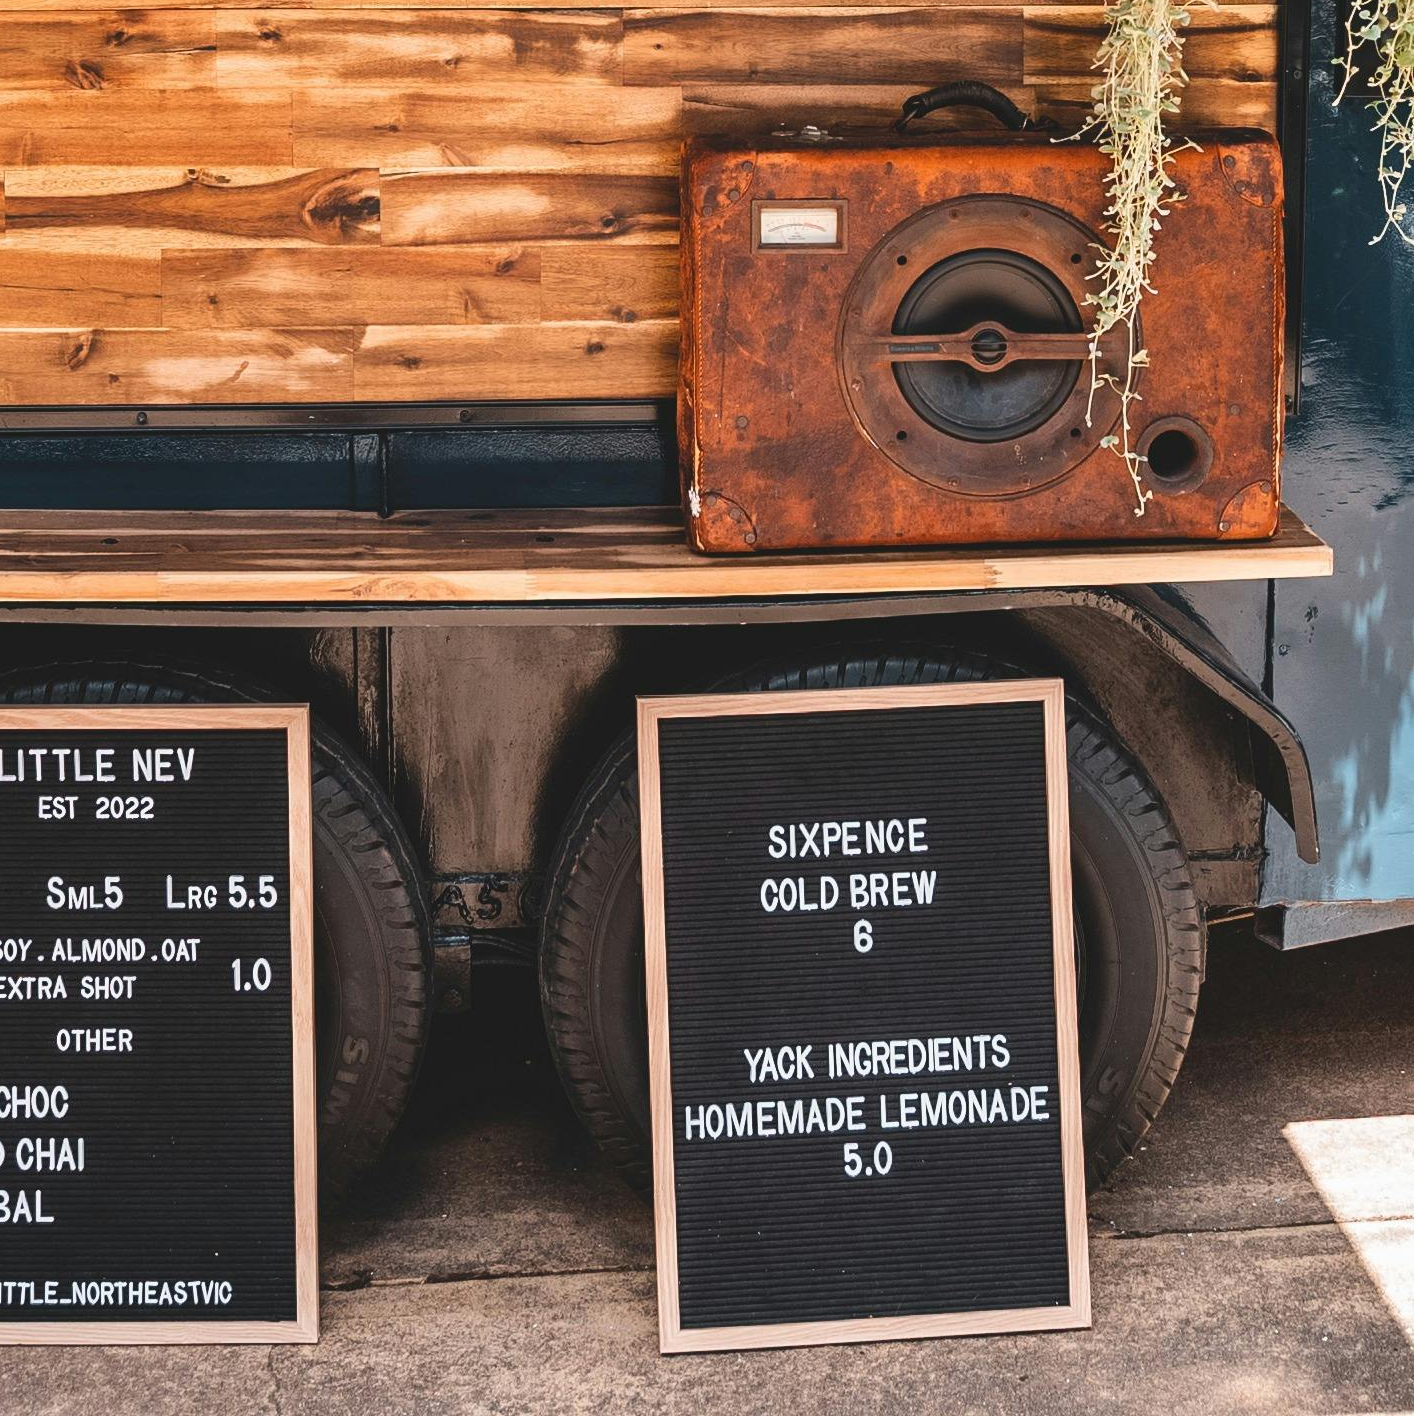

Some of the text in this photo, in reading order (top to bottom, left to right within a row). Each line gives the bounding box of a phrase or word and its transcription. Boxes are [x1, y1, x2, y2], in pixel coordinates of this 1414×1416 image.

[132, 747, 195, 782] NEV
[38, 795, 155, 820] EST 2022
[768, 817, 929, 859] SIXPENCE
[228, 874, 278, 909] 5.5
[760, 870, 937, 913] COLD BREW
[853, 918, 874, 954] 6
[80, 975, 138, 1000] SHOT
[231, 957, 272, 992] 1.0
[56, 1027, 133, 1053] OTHER
[743, 1033, 1011, 1084] YACK INGREDIENTS
[685, 1085, 1050, 1141] HOMEMADE LEMONADE
[15, 1137, 85, 1173] CHAI
[843, 1140, 893, 1178] 5.0
